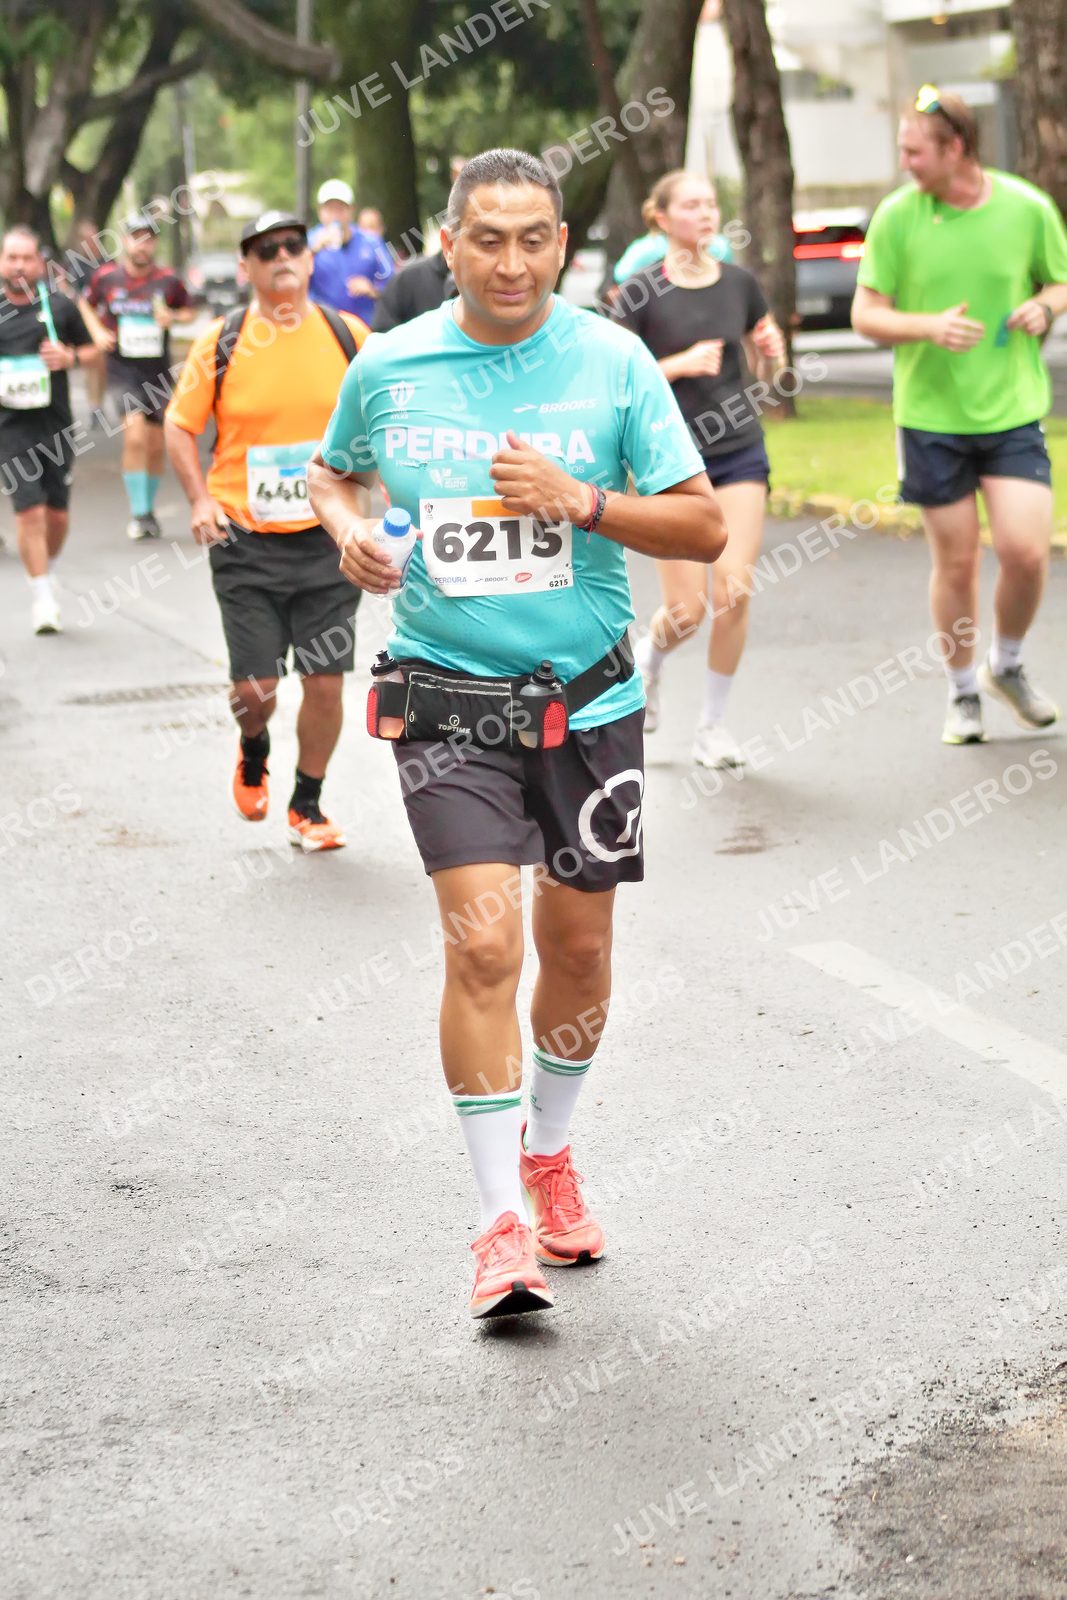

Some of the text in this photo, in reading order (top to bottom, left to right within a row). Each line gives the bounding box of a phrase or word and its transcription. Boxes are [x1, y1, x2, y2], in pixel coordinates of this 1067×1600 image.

[538, 399, 599, 414] BROOKS
[432, 519, 563, 563] 6215
[549, 579, 568, 588] 6215
[438, 723, 471, 734] TOPTIME
